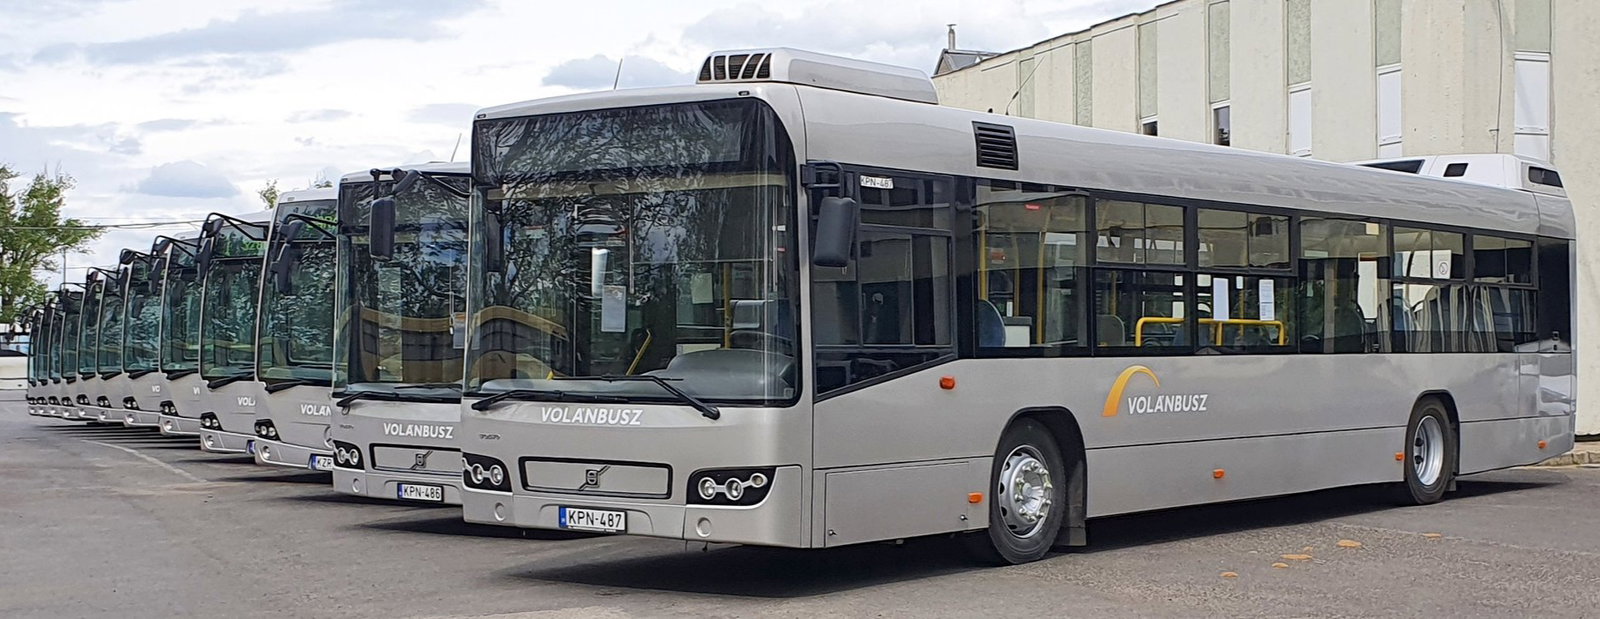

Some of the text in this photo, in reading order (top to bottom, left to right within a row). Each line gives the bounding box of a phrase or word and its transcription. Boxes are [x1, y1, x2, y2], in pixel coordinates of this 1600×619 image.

[1128, 394, 1208, 415] VOLÁNBUSZ
[541, 407, 643, 425] VOLÁNBUSZ
[383, 422, 454, 439] VOLÁNBUSZ
[403, 485, 441, 499] KPN-486
[568, 510, 622, 528] KPN-487
